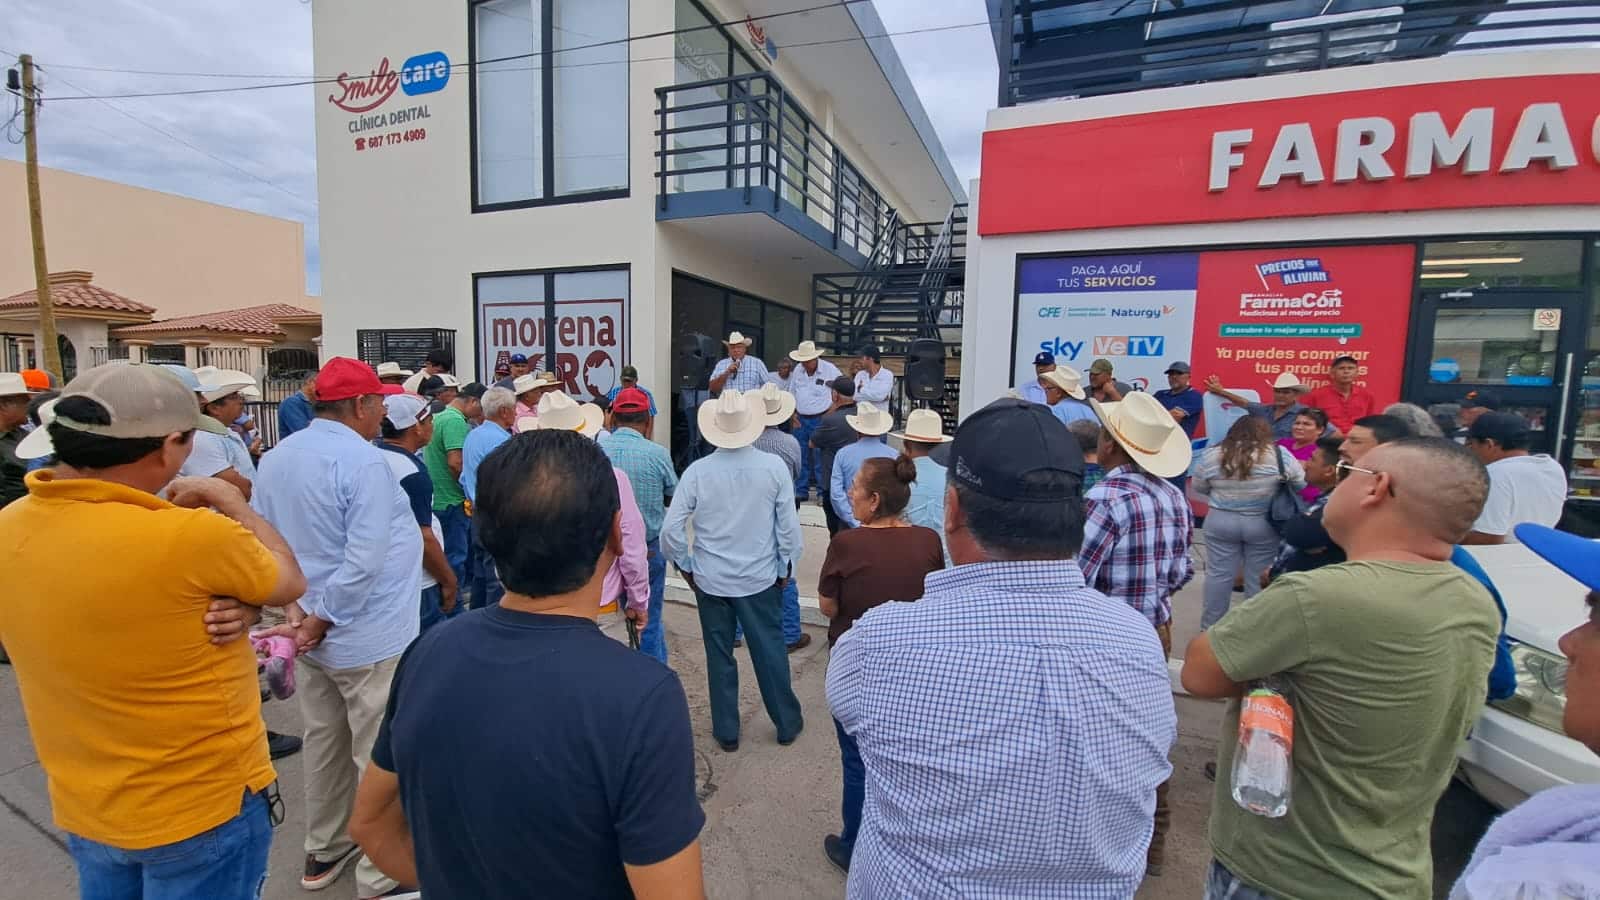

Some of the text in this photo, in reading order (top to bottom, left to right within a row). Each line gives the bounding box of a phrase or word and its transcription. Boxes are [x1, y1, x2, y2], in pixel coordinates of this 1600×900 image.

[328, 57, 447, 113] Smile care
[348, 105, 431, 134] CLÍNICA DENTAL
[386, 131, 402, 145] 173
[403, 127, 426, 143] 4909
[1208, 102, 1600, 193] FARMA
[1072, 261, 1142, 275] PAGA AQUÍ
[1260, 259, 1305, 275] PRECIOS
[1057, 275, 1156, 288] TUS SERVICIOS
[1283, 272, 1327, 285] ALIVIAN
[1038, 306, 1062, 318] CFE
[1110, 307, 1161, 319] Naturgy
[1289, 310, 1313, 318] mejor
[1314, 310, 1340, 318] precio
[492, 315, 616, 347] morena
[1298, 327, 1319, 336] para
[1330, 326, 1355, 335] salud
[1040, 335, 1083, 361] sky
[1095, 336, 1163, 356] VeTV
[1216, 347, 1232, 359] Ya
[1236, 347, 1295, 361] puedes
[1255, 362, 1368, 376] tus produs
